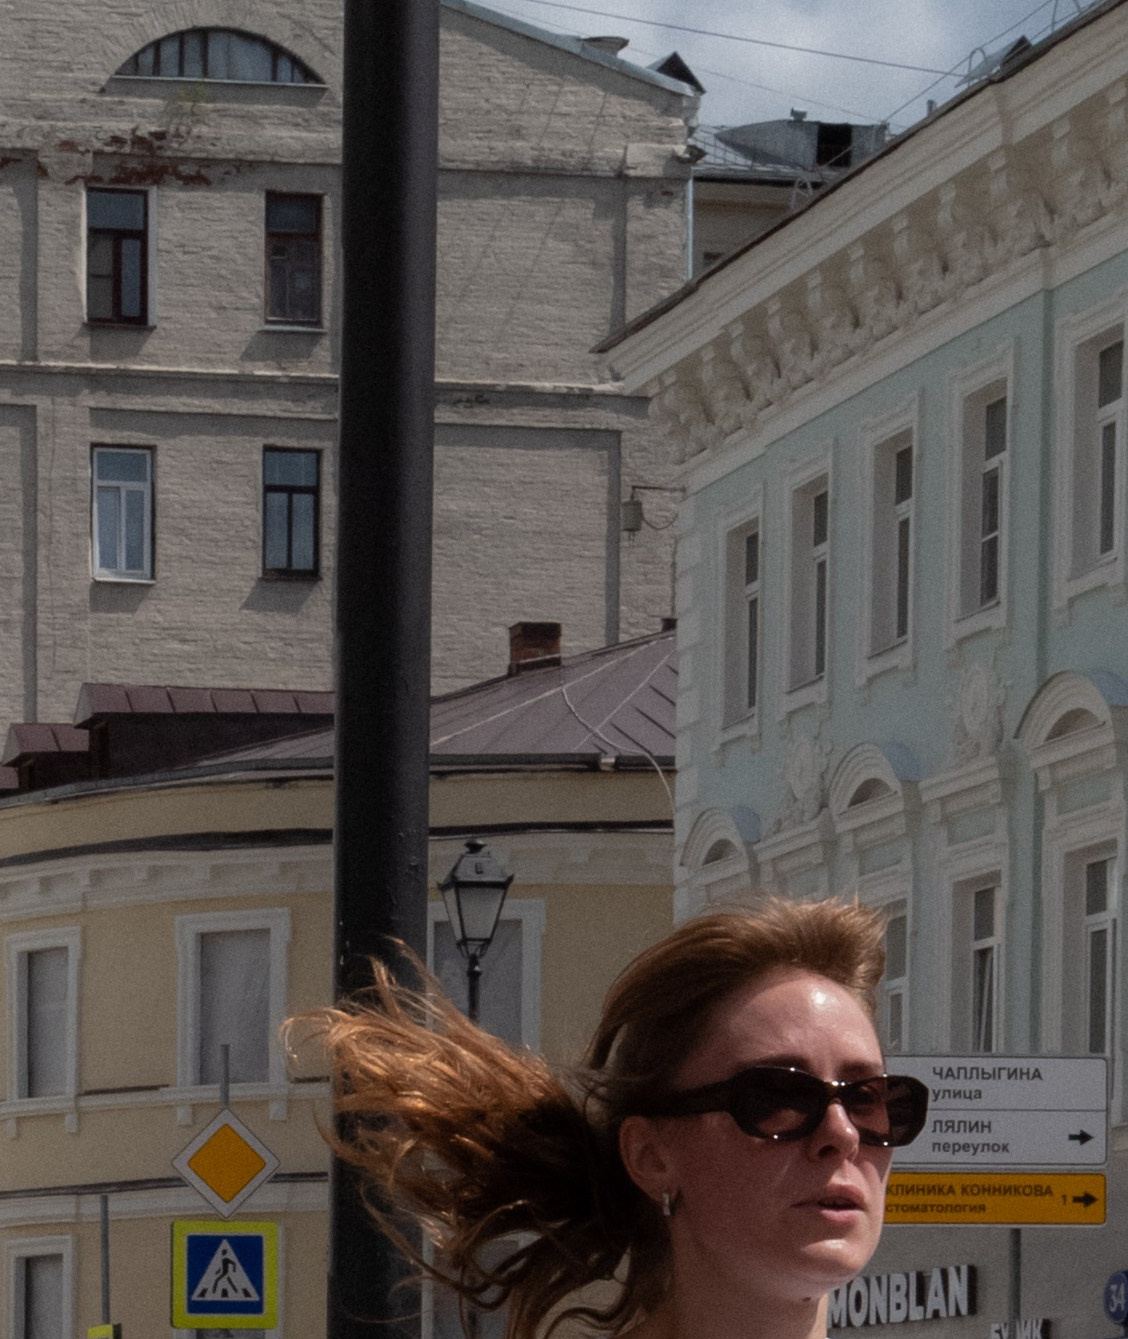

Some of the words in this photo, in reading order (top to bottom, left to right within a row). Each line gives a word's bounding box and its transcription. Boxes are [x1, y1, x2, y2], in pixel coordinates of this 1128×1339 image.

[932, 1066, 1043, 1081] ЧАПЛЫГИНА
[931, 1088, 982, 1101] улица
[932, 1119, 992, 1134] ЛЯЛИН
[931, 1142, 1010, 1155] переулок
[886, 1183, 956, 1197] КЛИНИКА
[961, 1183, 1054, 1197] КОННИКОВА
[885, 1203, 987, 1214] стоматология
[828, 1264, 970, 1328] MONBLAN
